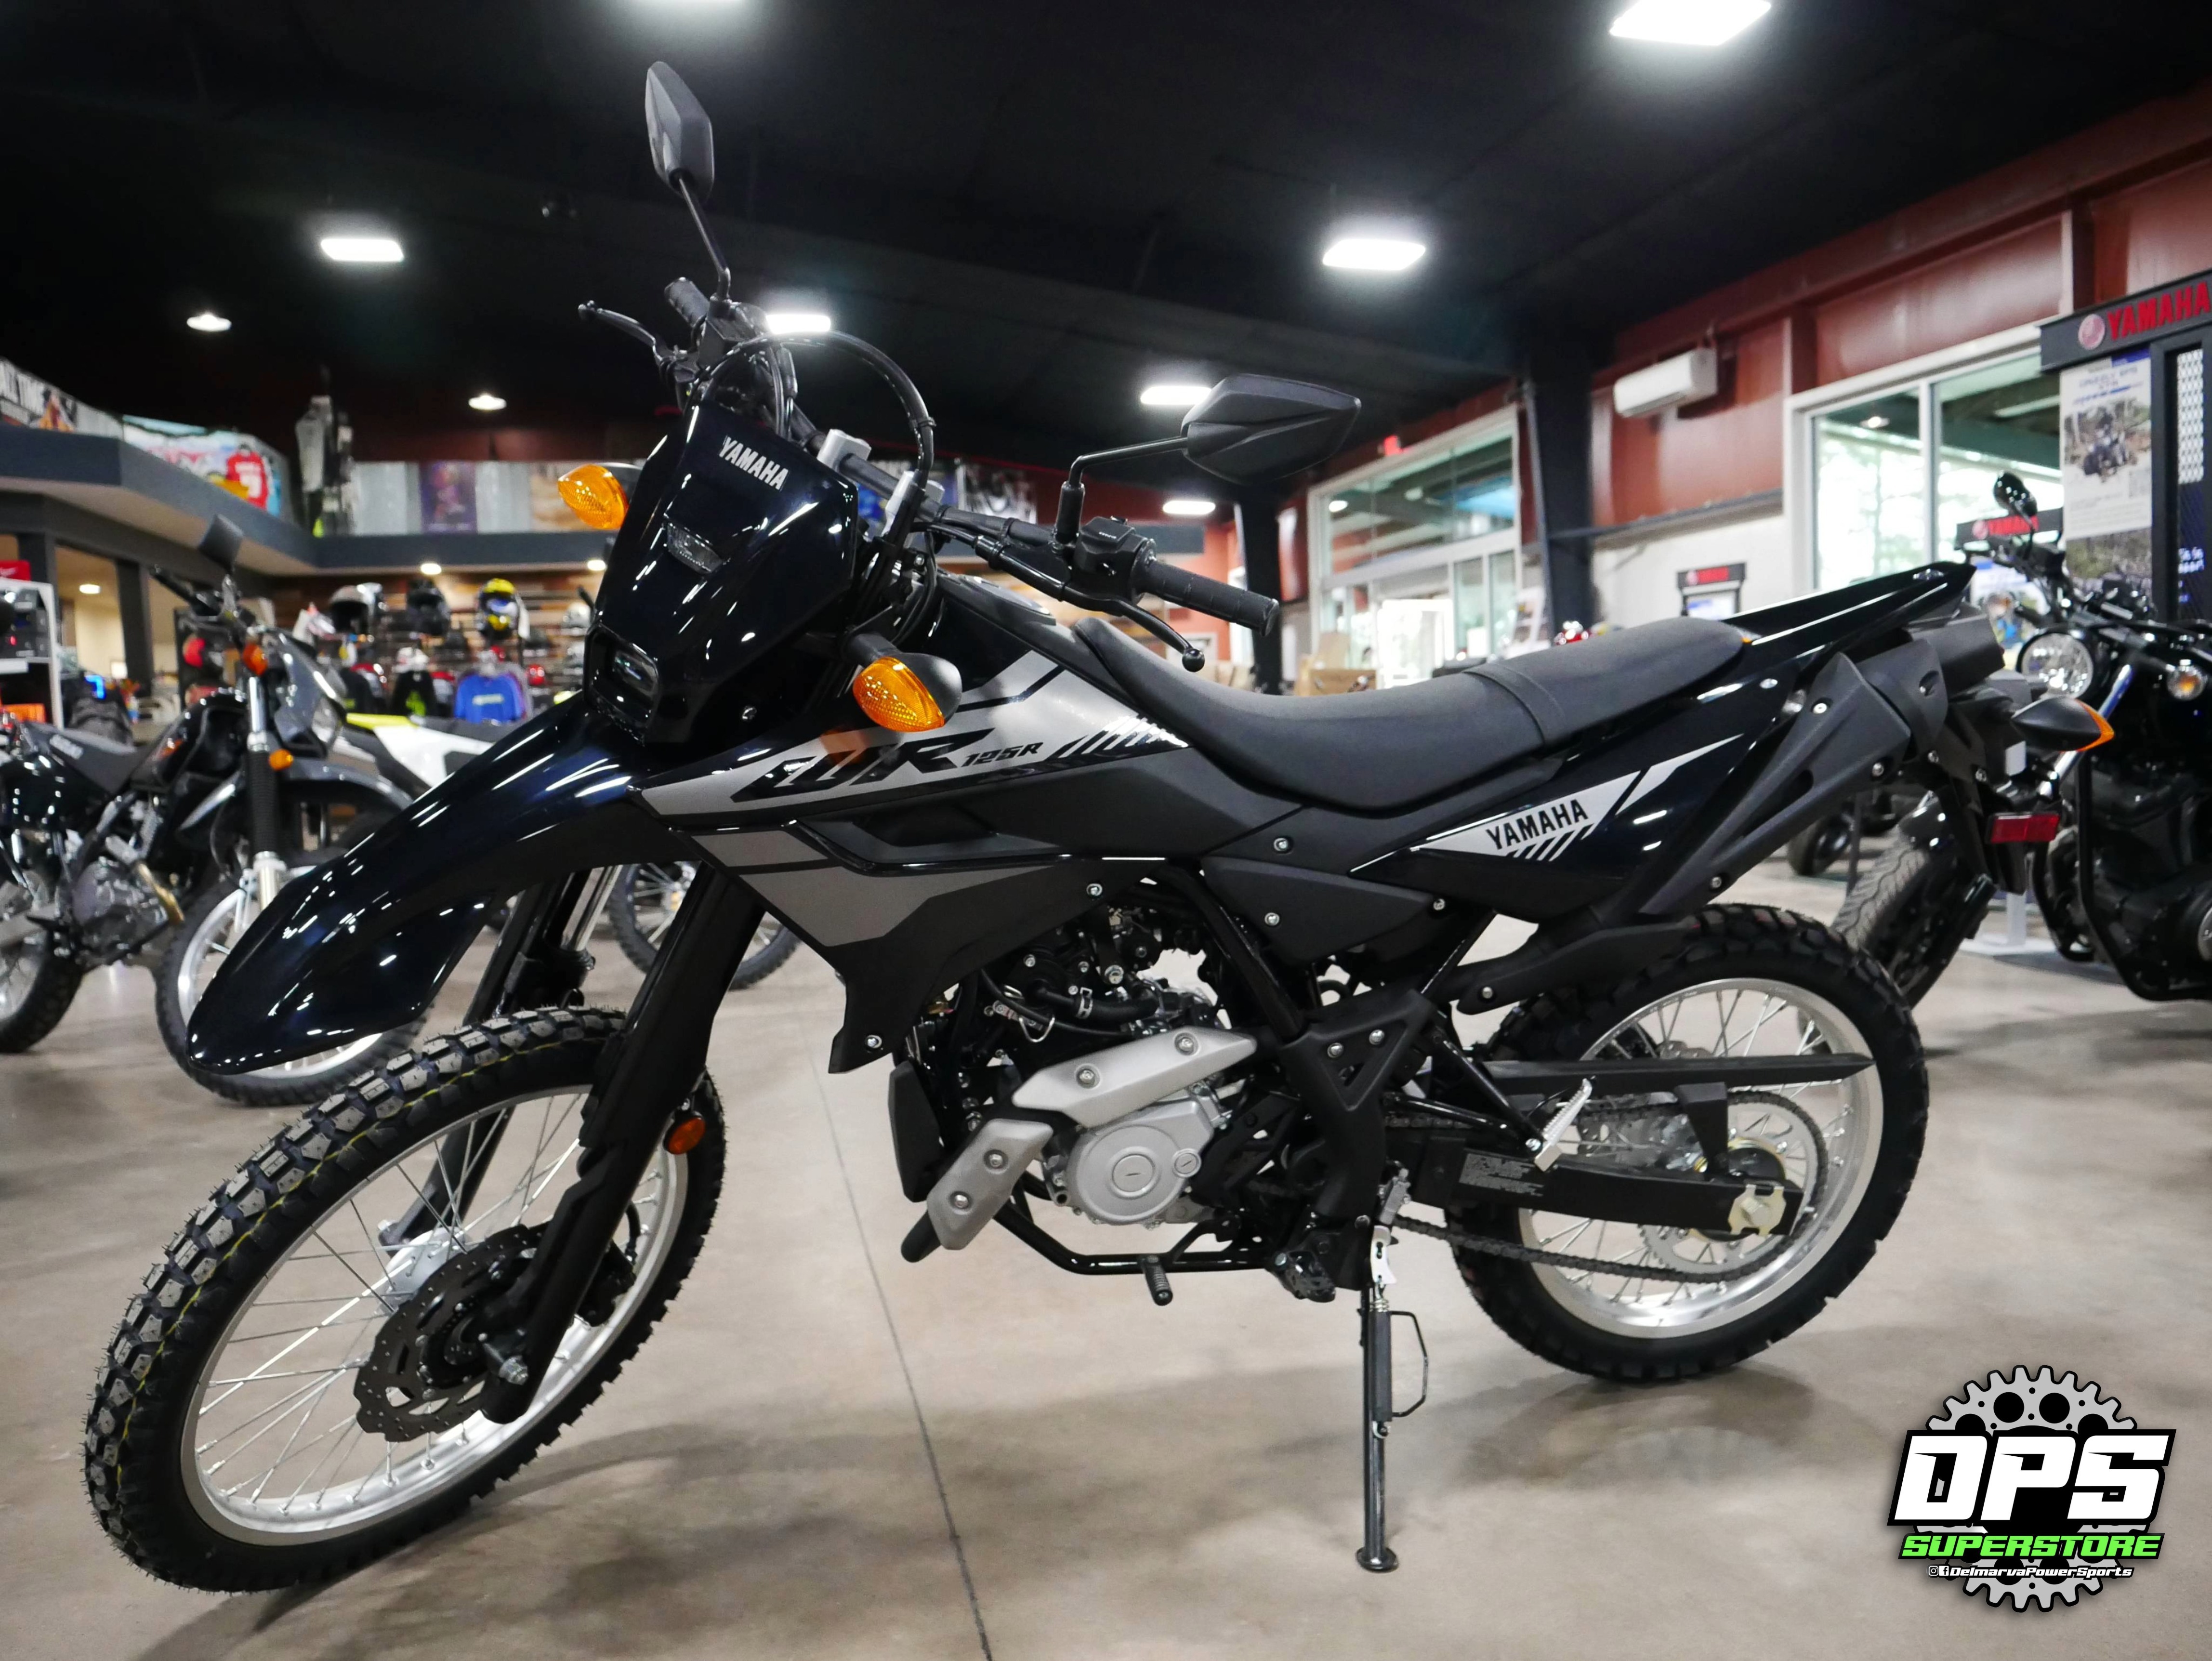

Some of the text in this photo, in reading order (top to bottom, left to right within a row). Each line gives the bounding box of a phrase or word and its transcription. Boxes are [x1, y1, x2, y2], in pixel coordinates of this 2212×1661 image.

[2107, 281, 2210, 342] YAMAHA
[719, 436, 789, 490] YAMAHA
[961, 742, 1043, 767] 125R
[1486, 799, 1589, 850] YAMAHA
